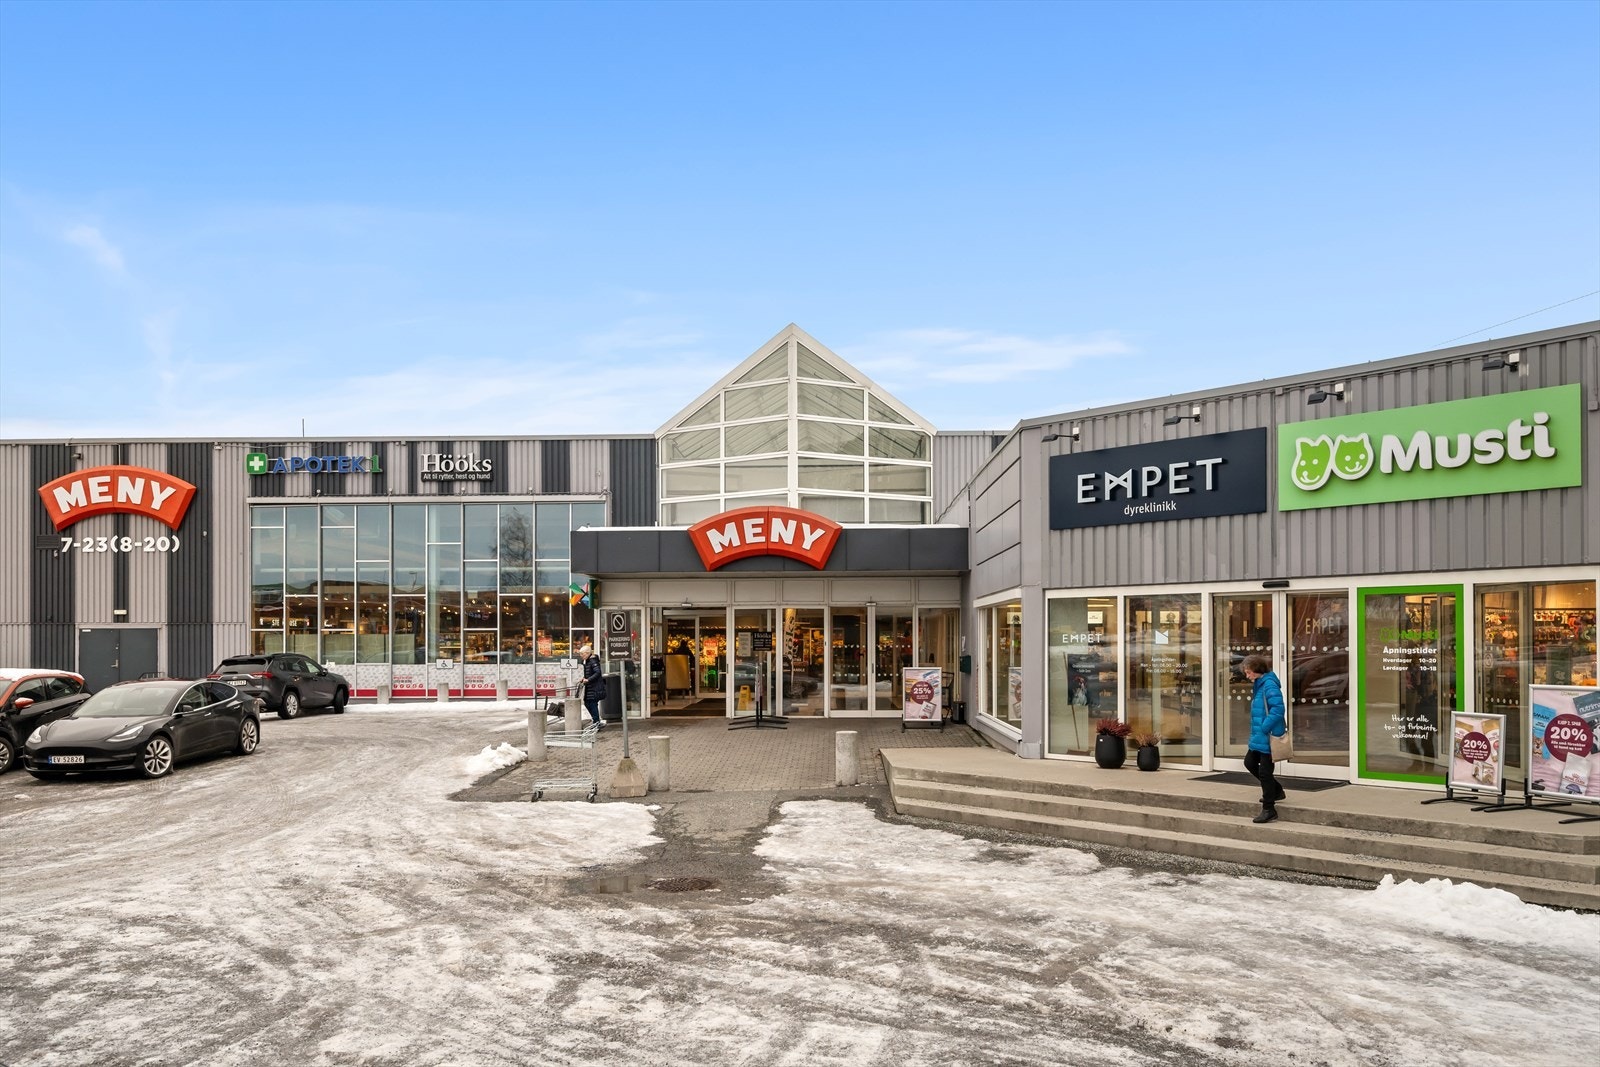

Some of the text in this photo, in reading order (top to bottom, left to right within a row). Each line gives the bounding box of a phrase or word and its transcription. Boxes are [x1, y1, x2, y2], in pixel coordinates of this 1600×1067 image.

[1380, 411, 1556, 474] Musti
[273, 454, 383, 474] APOTEK 1
[421, 452, 492, 472] Hööks
[1077, 457, 1223, 504] EMPET
[52, 475, 177, 514] MENY
[1124, 500, 1177, 517] dyreklinikk
[706, 517, 826, 554] MENY
[61, 535, 180, 554] 7-23(8-20)
[1305, 616, 1342, 635] EMPET
[1062, 633, 1103, 643] EMPET
[1382, 645, 1438, 655] Åpningstider
[913, 687, 932, 695] 25%
[1391, 713, 1405, 722] Her
[1416, 714, 1430, 723] alle
[1384, 723, 1396, 731] to-
[1407, 722, 1438, 732] firbeinte
[1391, 731, 1429, 740] velkommen!
[1550, 726, 1588, 742] 20%
[1463, 739, 1488, 750] 20%
